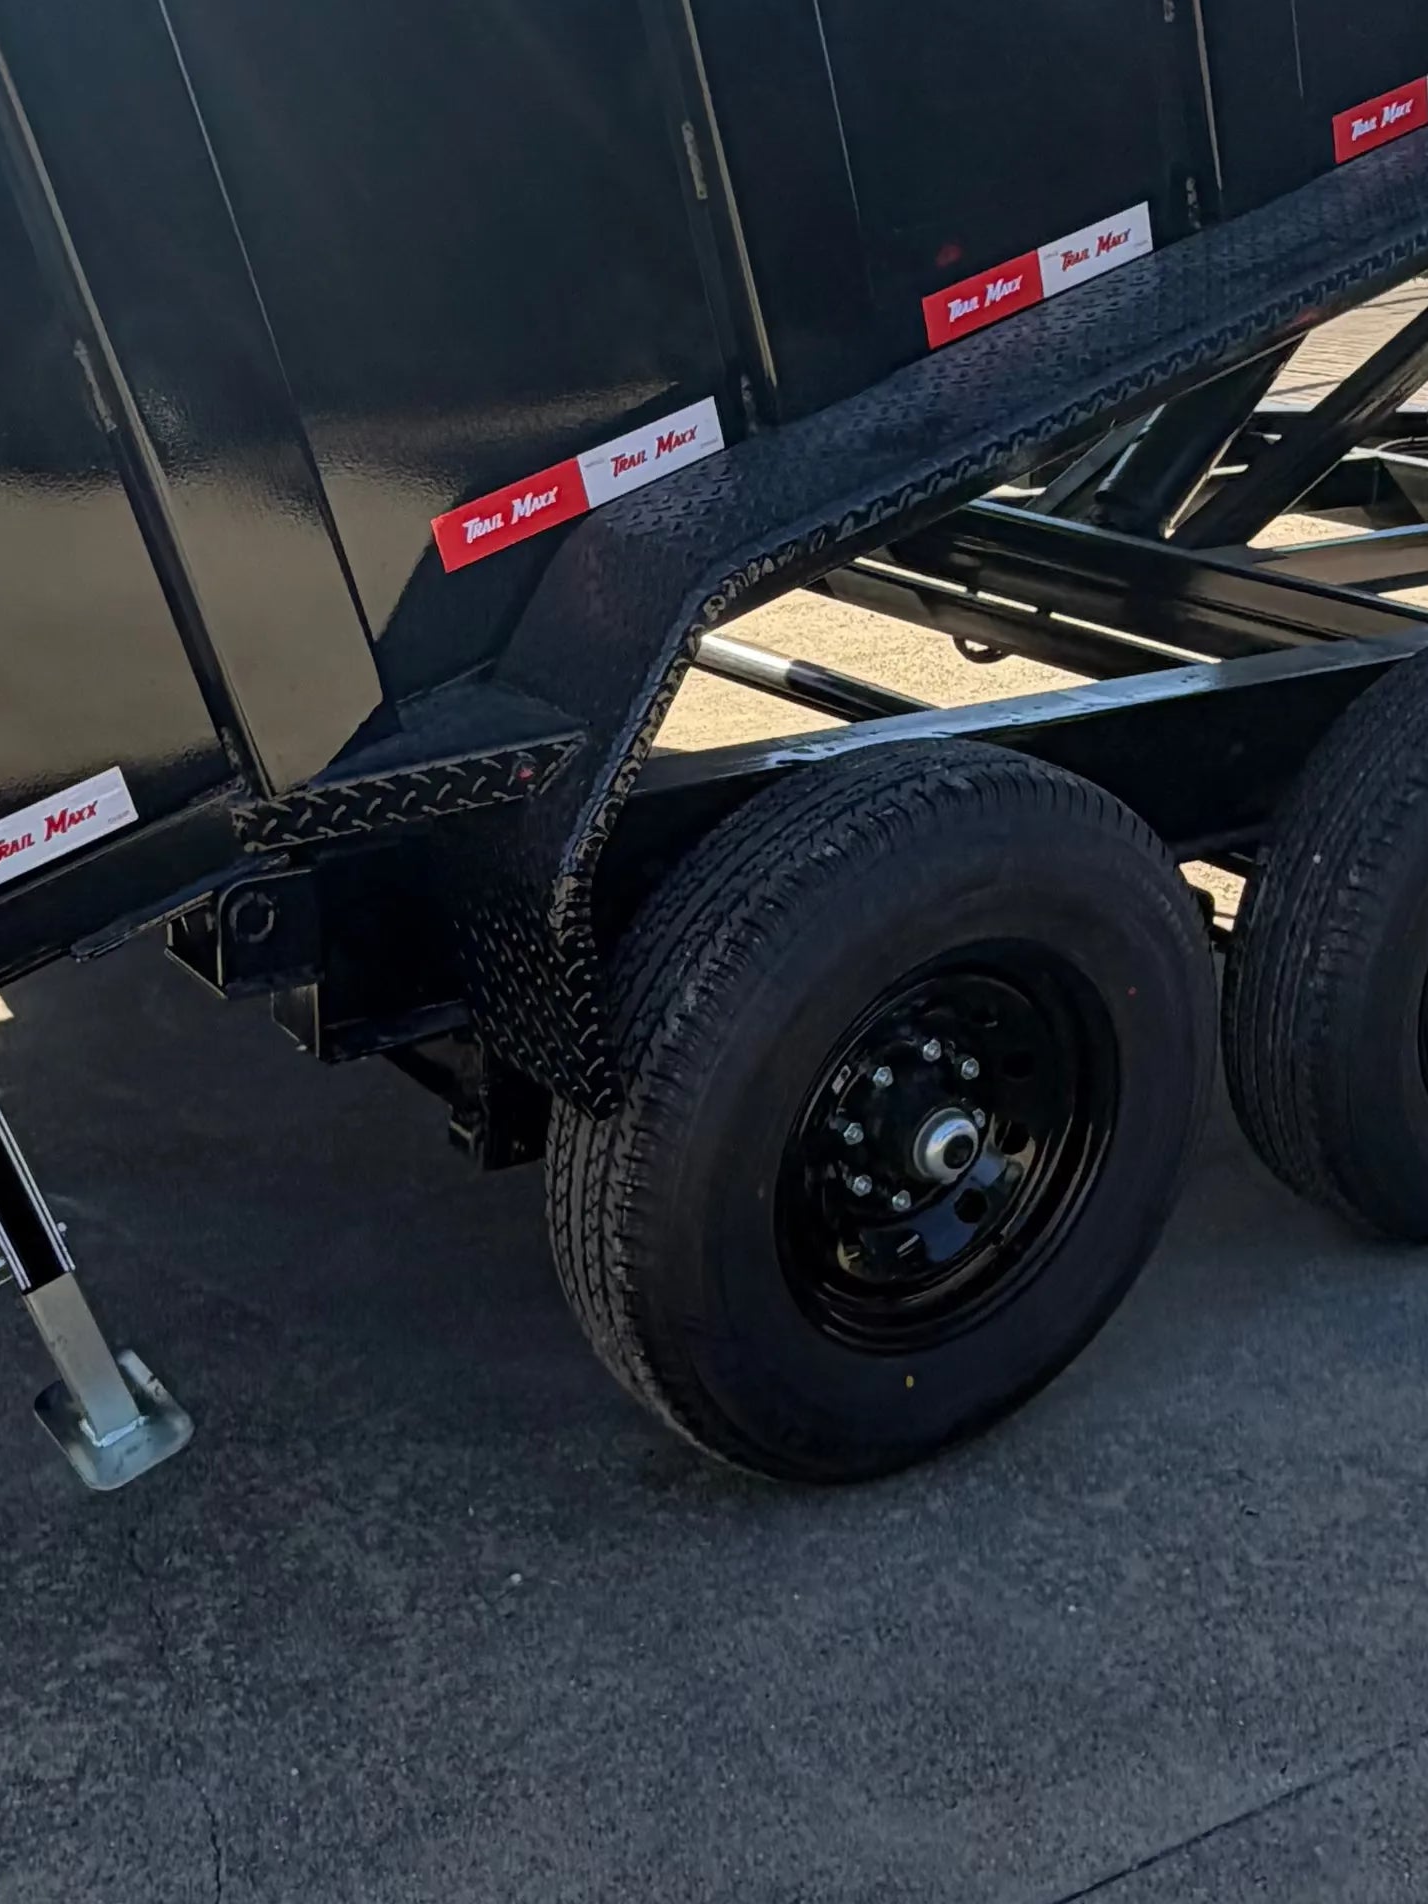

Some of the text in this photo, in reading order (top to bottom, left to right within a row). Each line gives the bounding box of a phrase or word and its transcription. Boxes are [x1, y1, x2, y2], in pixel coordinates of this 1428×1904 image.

[610, 424, 698, 478] TRAIL MAXX
[462, 486, 559, 544] TRAIL MAXX
[43, 800, 99, 842] MAXX
